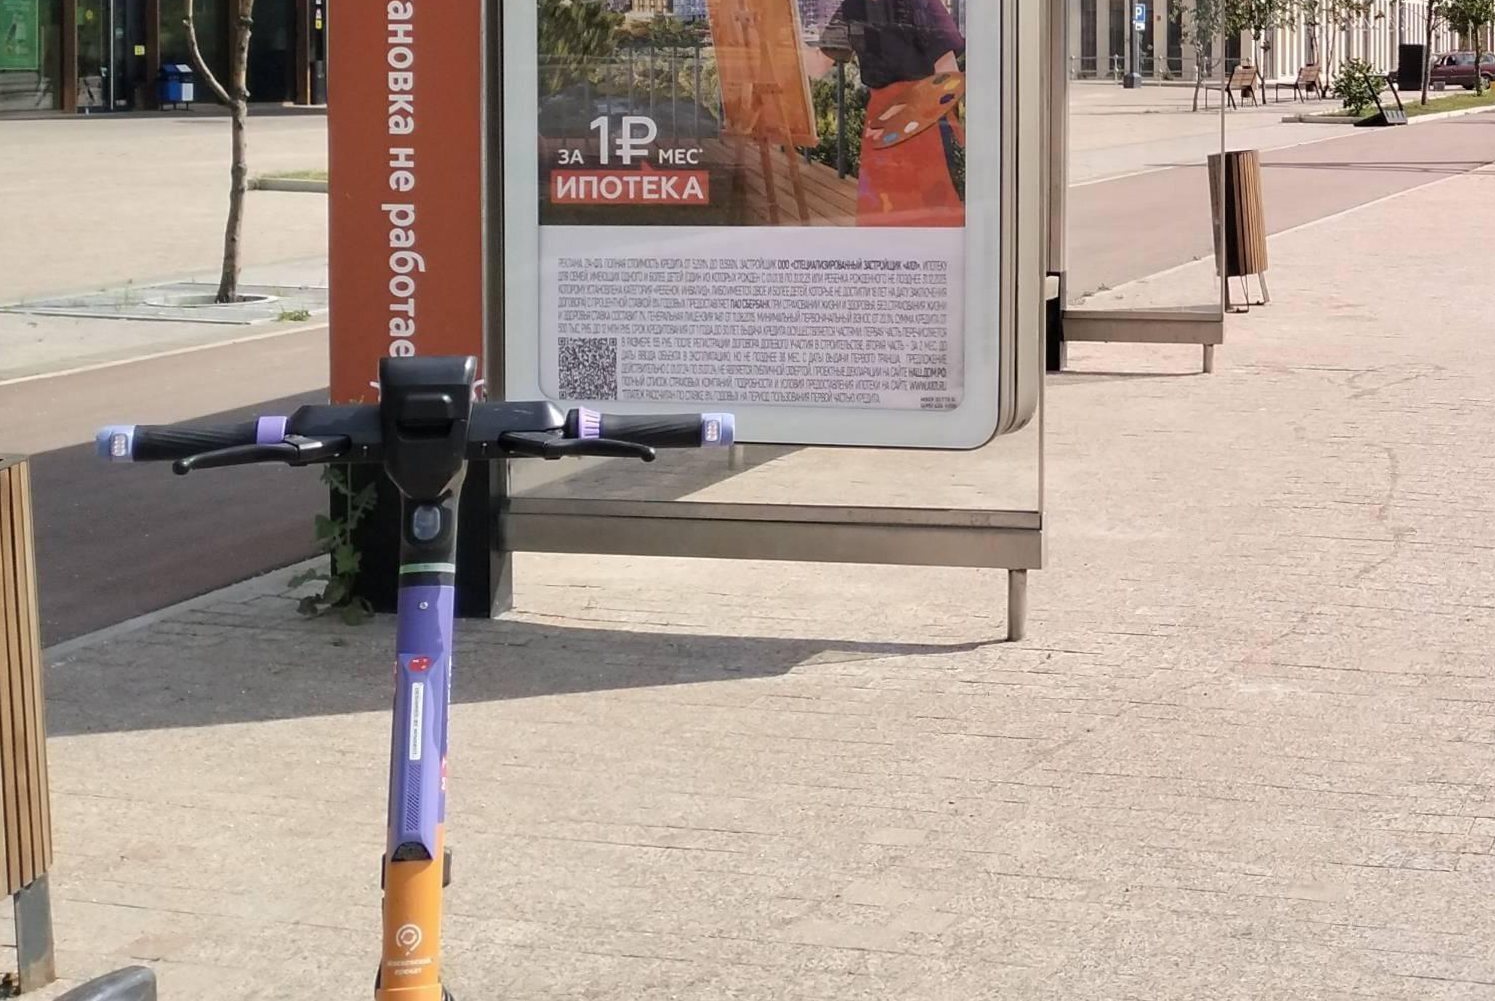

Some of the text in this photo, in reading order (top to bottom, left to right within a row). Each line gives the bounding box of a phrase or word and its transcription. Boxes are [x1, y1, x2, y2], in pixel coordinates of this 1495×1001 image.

[388, 147, 416, 192] не
[558, 149, 584, 165] ЗА
[556, 175, 704, 200] ИПОТЕКА
[381, 203, 425, 358] работае
